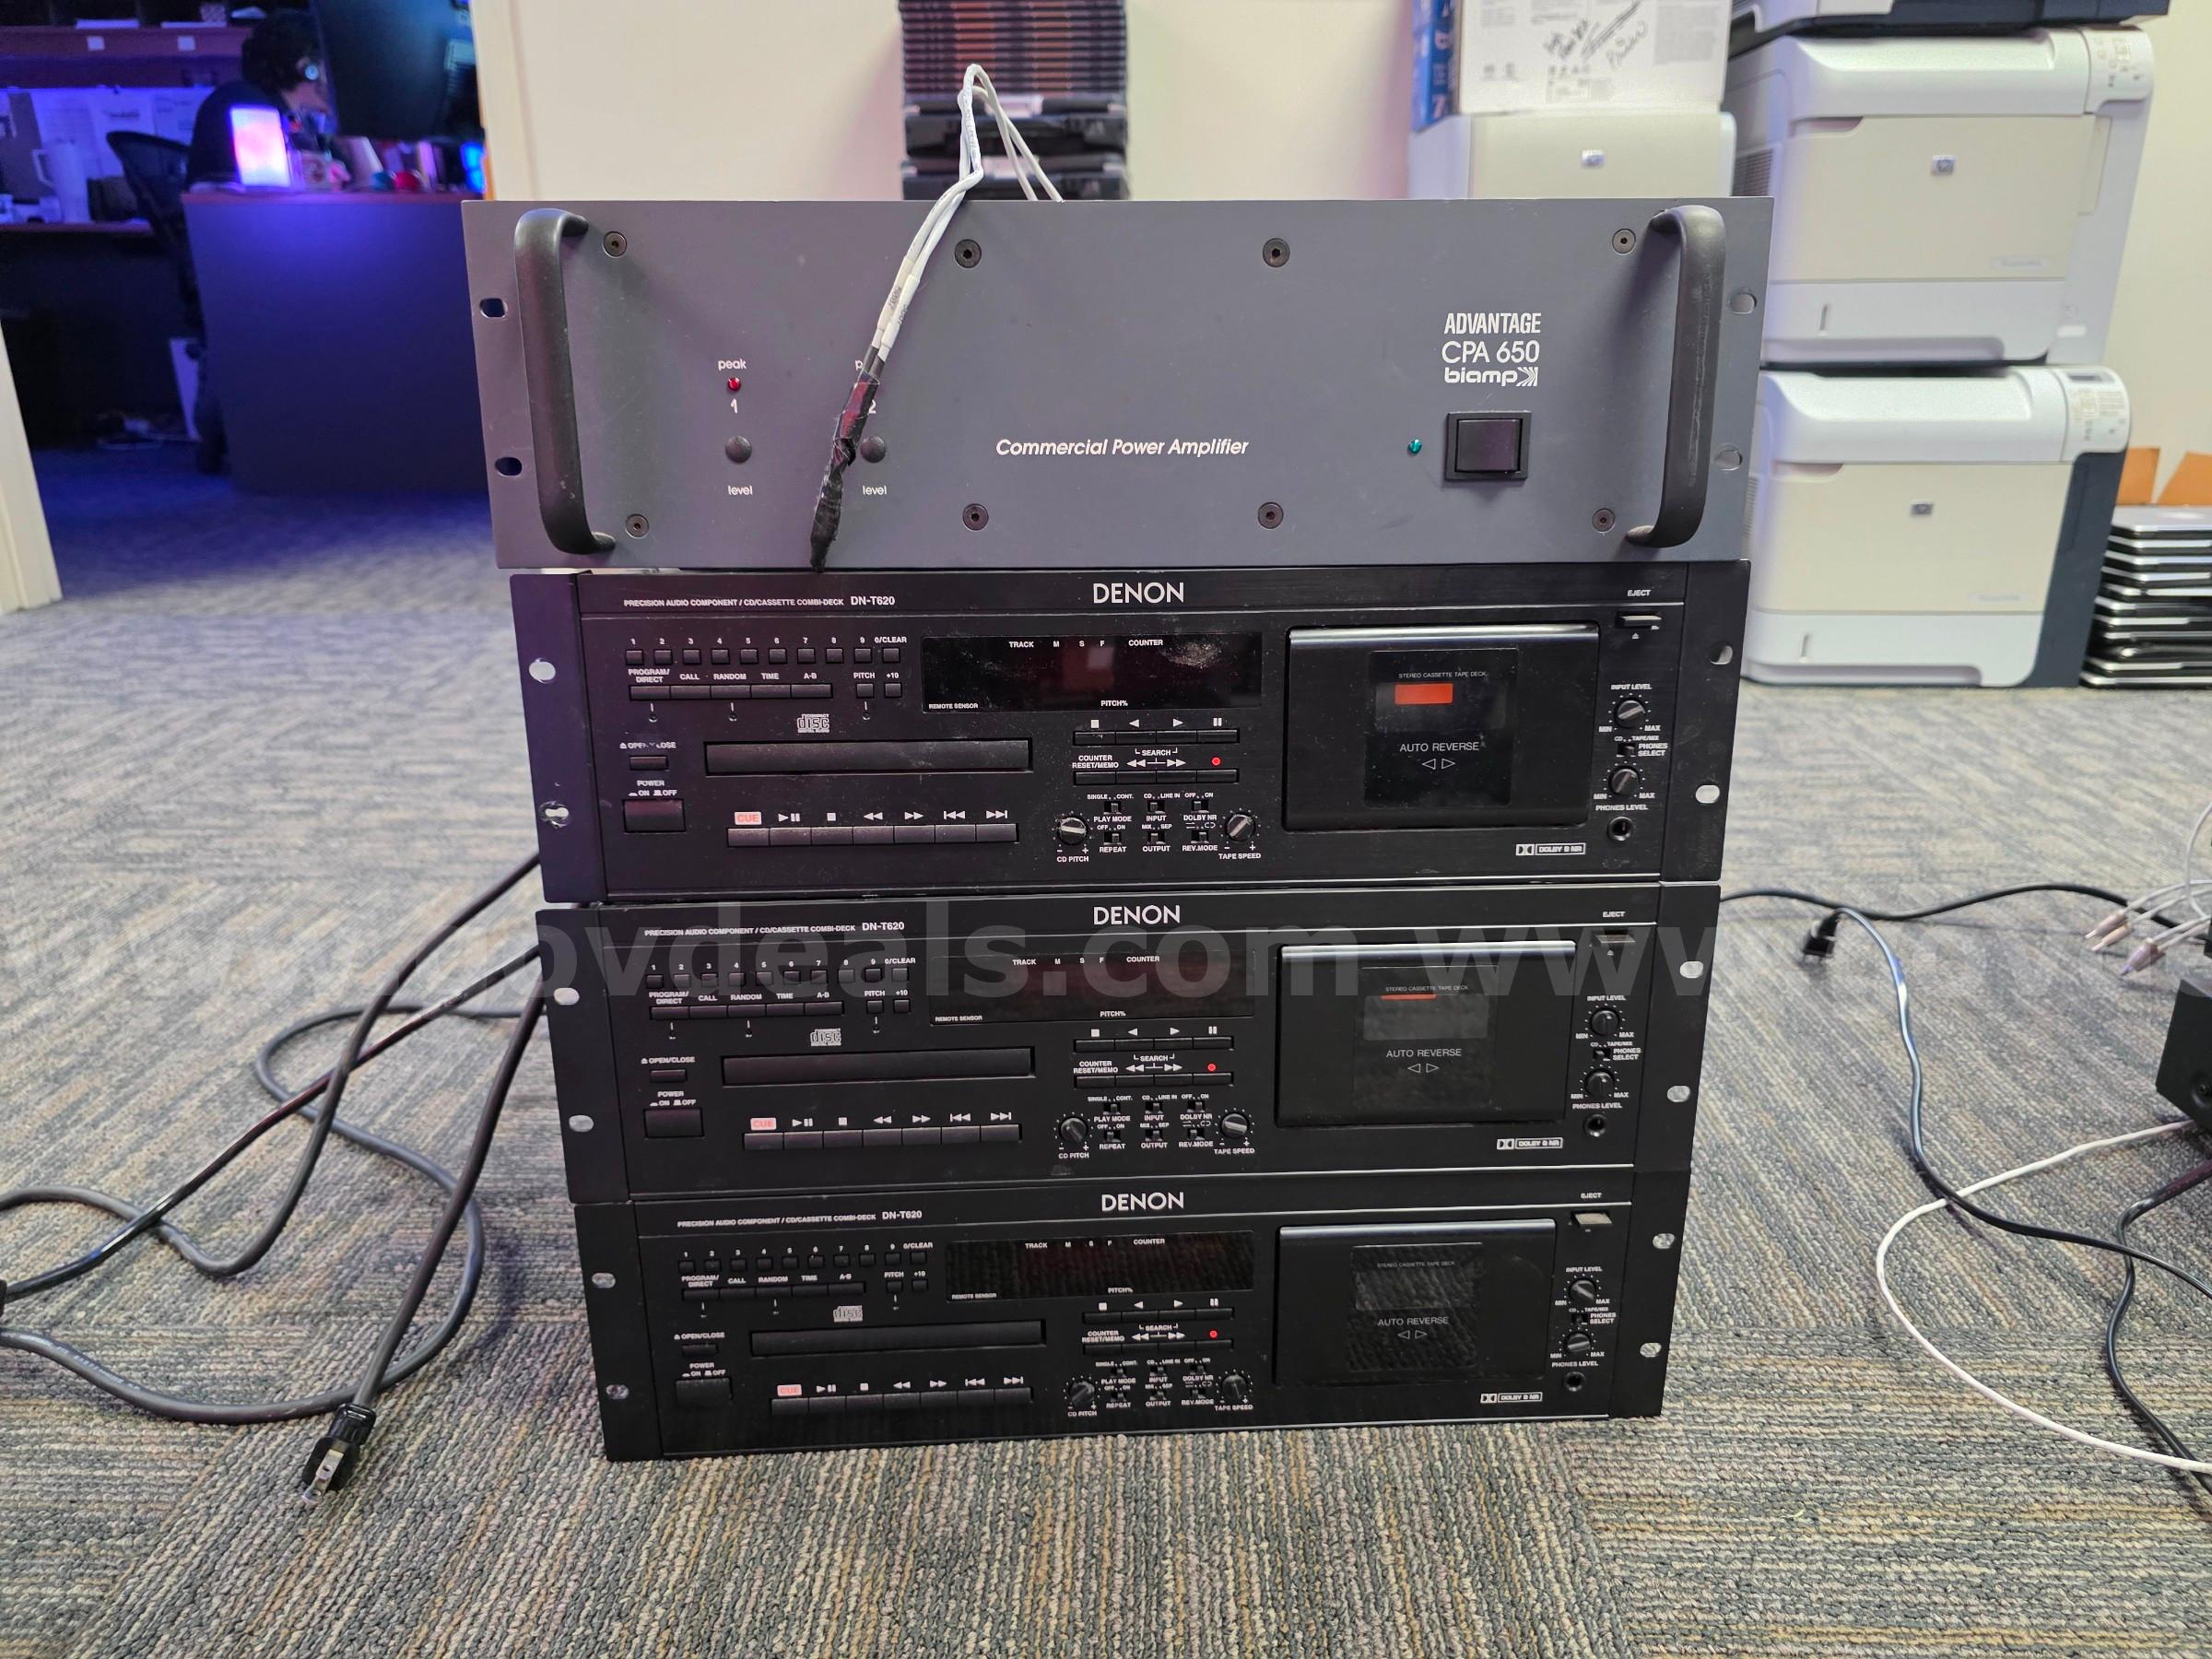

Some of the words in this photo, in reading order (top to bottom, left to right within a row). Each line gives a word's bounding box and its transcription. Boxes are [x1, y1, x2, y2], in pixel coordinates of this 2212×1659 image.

[1444, 313, 1541, 334] ADVANTAGE
[1442, 341, 1489, 363] CPA
[1497, 340, 1539, 363] 650
[718, 359, 747, 371] peak
[1444, 367, 1519, 386] biamp
[731, 399, 737, 413] 1
[996, 440, 1108, 454] Commercial
[1112, 440, 1165, 454] Power
[1168, 439, 1249, 457] Amplifier
[728, 486, 752, 495] level
[863, 486, 887, 495] level
[1093, 582, 1183, 603] DENON
[851, 596, 895, 605] DN-T620
[1400, 743, 1429, 752] AUTO
[1432, 742, 1478, 751] REVERSE
[1094, 905, 1180, 924] DENON
[862, 922, 904, 931] DN-T620
[1102, 1193, 1183, 1211] DENON
[882, 1210, 922, 1219] DN-T620
[1377, 1318, 1404, 1326] AUTO
